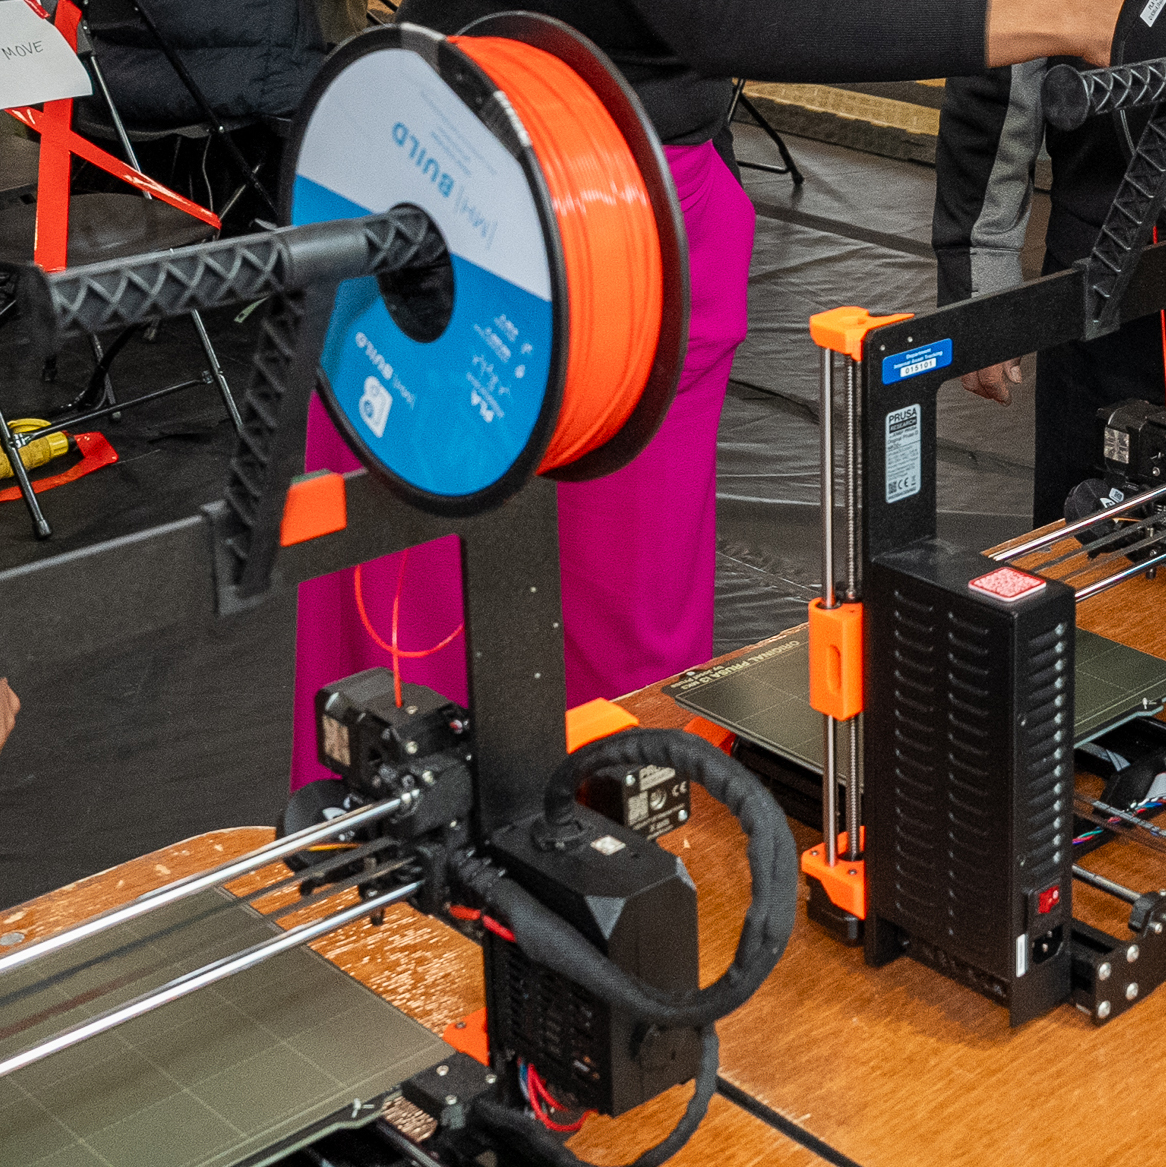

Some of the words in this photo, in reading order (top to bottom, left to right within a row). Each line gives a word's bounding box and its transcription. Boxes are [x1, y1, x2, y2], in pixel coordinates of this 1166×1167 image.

[1, 40, 44, 60] MOVE
[391, 122, 455, 198] BUILD
[905, 360, 933, 374] 015101
[888, 407, 917, 424] PRUSA
[748, 640, 800, 662] ORIGINAL
[713, 660, 750, 678] PRUSA
